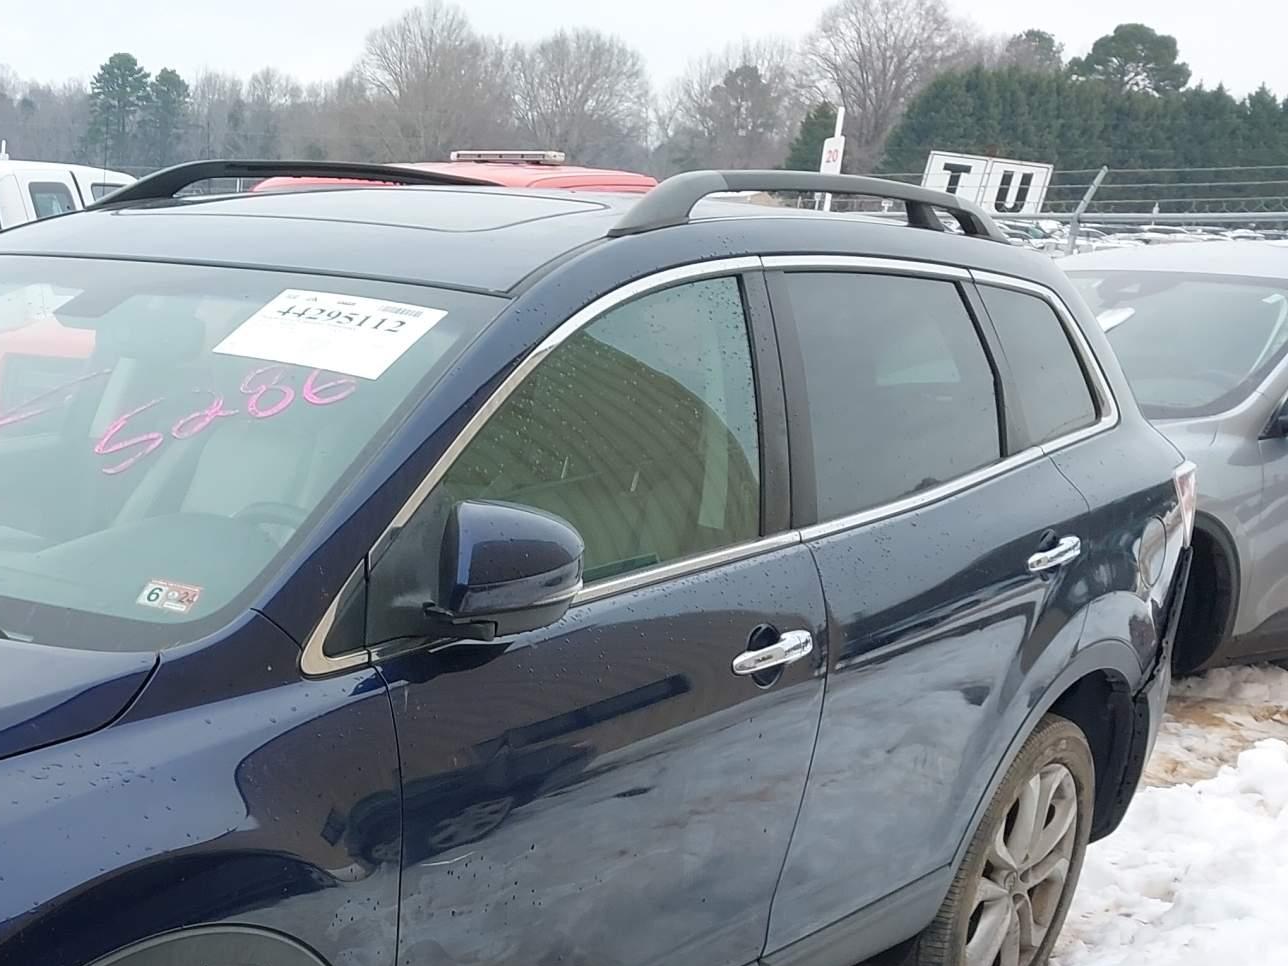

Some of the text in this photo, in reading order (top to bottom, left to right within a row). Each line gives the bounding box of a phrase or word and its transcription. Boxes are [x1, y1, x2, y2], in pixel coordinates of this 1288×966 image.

[825, 149, 840, 164] 20
[276, 304, 407, 334] 44295112
[146, 587, 163, 602] 6
